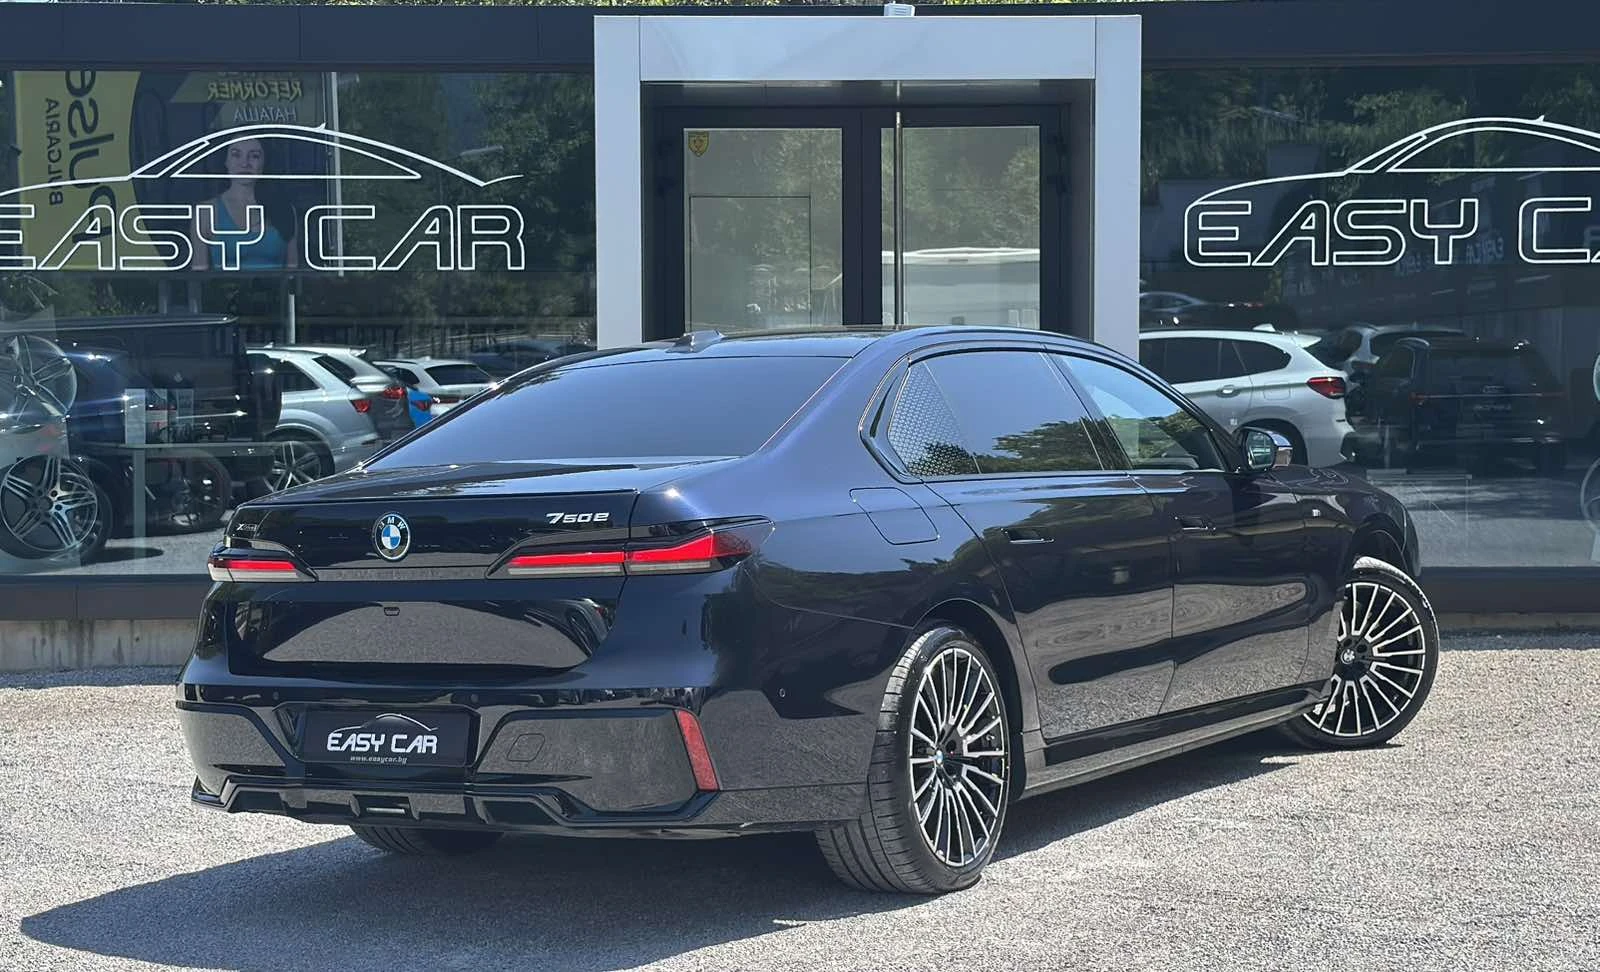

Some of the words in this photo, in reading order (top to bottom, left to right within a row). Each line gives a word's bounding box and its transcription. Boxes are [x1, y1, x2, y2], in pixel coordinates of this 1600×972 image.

[304, 204, 525, 271] CAR
[1184, 198, 1479, 267] EASY
[1518, 196, 1600, 264] C
[378, 516, 406, 530] BMW
[326, 733, 385, 752] EASY
[391, 734, 438, 754] CAR
[350, 755, 408, 765] www.easycar.bg
